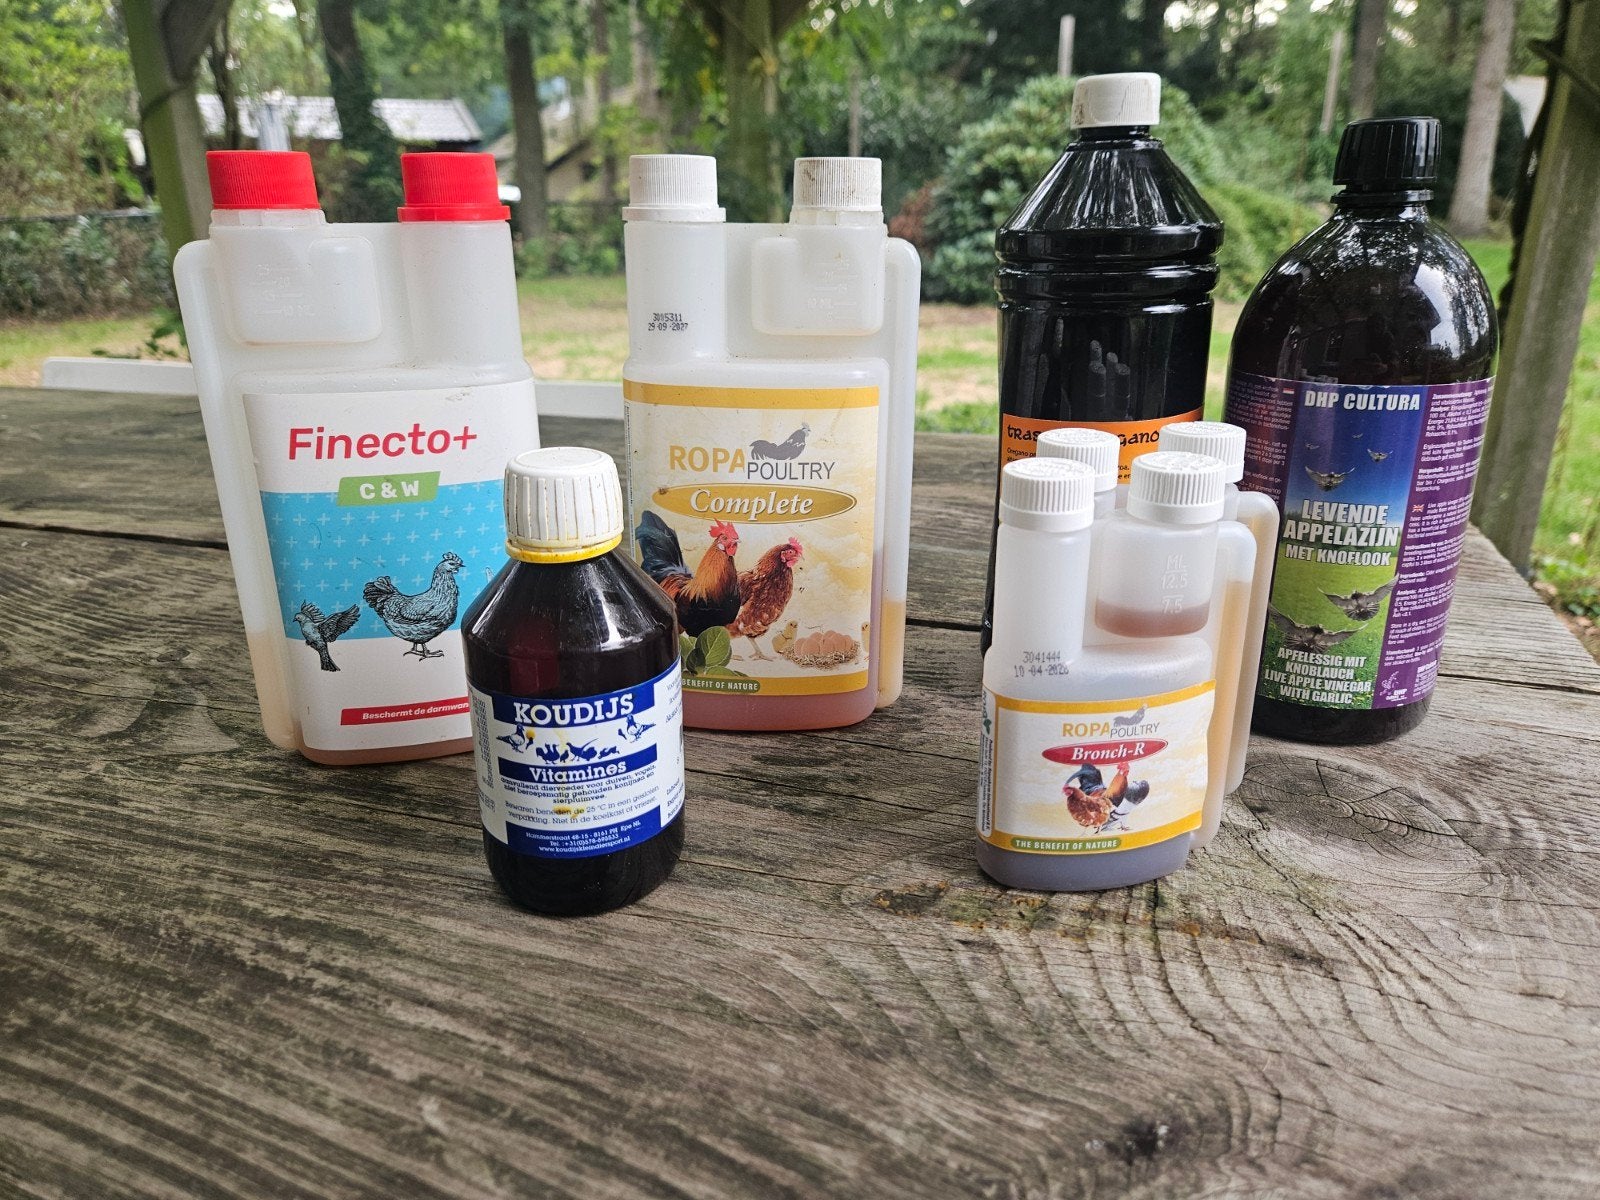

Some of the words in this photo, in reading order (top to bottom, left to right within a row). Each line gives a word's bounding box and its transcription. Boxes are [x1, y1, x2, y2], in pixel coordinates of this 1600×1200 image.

[1304, 390, 1339, 408] DHP
[1343, 392, 1421, 411] CULTURA
[288, 422, 477, 460] Finecto+
[669, 444, 745, 473] ROPA
[747, 461, 836, 481] POULTRY
[359, 482, 376, 500] C
[380, 481, 398, 498] &
[400, 480, 420, 497] W
[690, 488, 814, 521] Complete
[1301, 499, 1389, 526] LEVENDE
[1283, 520, 1400, 547] APPELAZIJN
[1285, 544, 1314, 560] MET
[1317, 549, 1392, 566] KNOFLOOK
[1161, 573, 1188, 590] 12.5
[1162, 598, 1183, 613] 7.5
[1022, 650, 1061, 663] 3041444
[1277, 646, 1343, 666] APFELESSIG
[1344, 654, 1367, 668] MIT
[1264, 669, 1288, 683] LIVE
[1288, 673, 1323, 689] APPLE
[1324, 679, 1372, 692] VINEGAR
[1285, 661, 1355, 680] KNOBLAUCH
[716, 681, 725, 689] OF
[727, 681, 758, 690] NATURE
[1280, 684, 1311, 701] WITH
[1313, 689, 1354, 705] GARLIC
[362, 708, 412, 721] Beschermt
[414, 707, 426, 715] de
[427, 702, 469, 714] darmwan
[513, 692, 635, 725] KOUDIJS
[1062, 722, 1110, 737] ROPA
[1110, 722, 1160, 738] POULTRY
[1071, 741, 1145, 761] Bronch-R
[529, 761, 627, 783] Vitamines
[501, 777, 539, 791] aanvullend
[541, 783, 584, 792] diervoeder
[585, 780, 604, 789] voor
[518, 787, 571, 800] beroepsmatig
[572, 786, 613, 799] gehouden
[614, 776, 645, 793] konijnen
[646, 770, 655, 779] en
[505, 801, 539, 815] Bewaren
[540, 806, 572, 816] beneden
[573, 806, 585, 815] de
[586, 806, 596, 814] 25
[608, 801, 615, 809] in
[616, 797, 631, 808] een
[552, 815, 569, 824] Niet
[570, 815, 578, 824] in
[579, 814, 591, 823] de
[592, 807, 627, 822] koelkast
[627, 806, 634, 814] of
[1015, 839, 1032, 848] THE
[1034, 841, 1069, 850] BENEFIT
[1072, 842, 1083, 850] OF
[1085, 839, 1117, 849] NATURE
